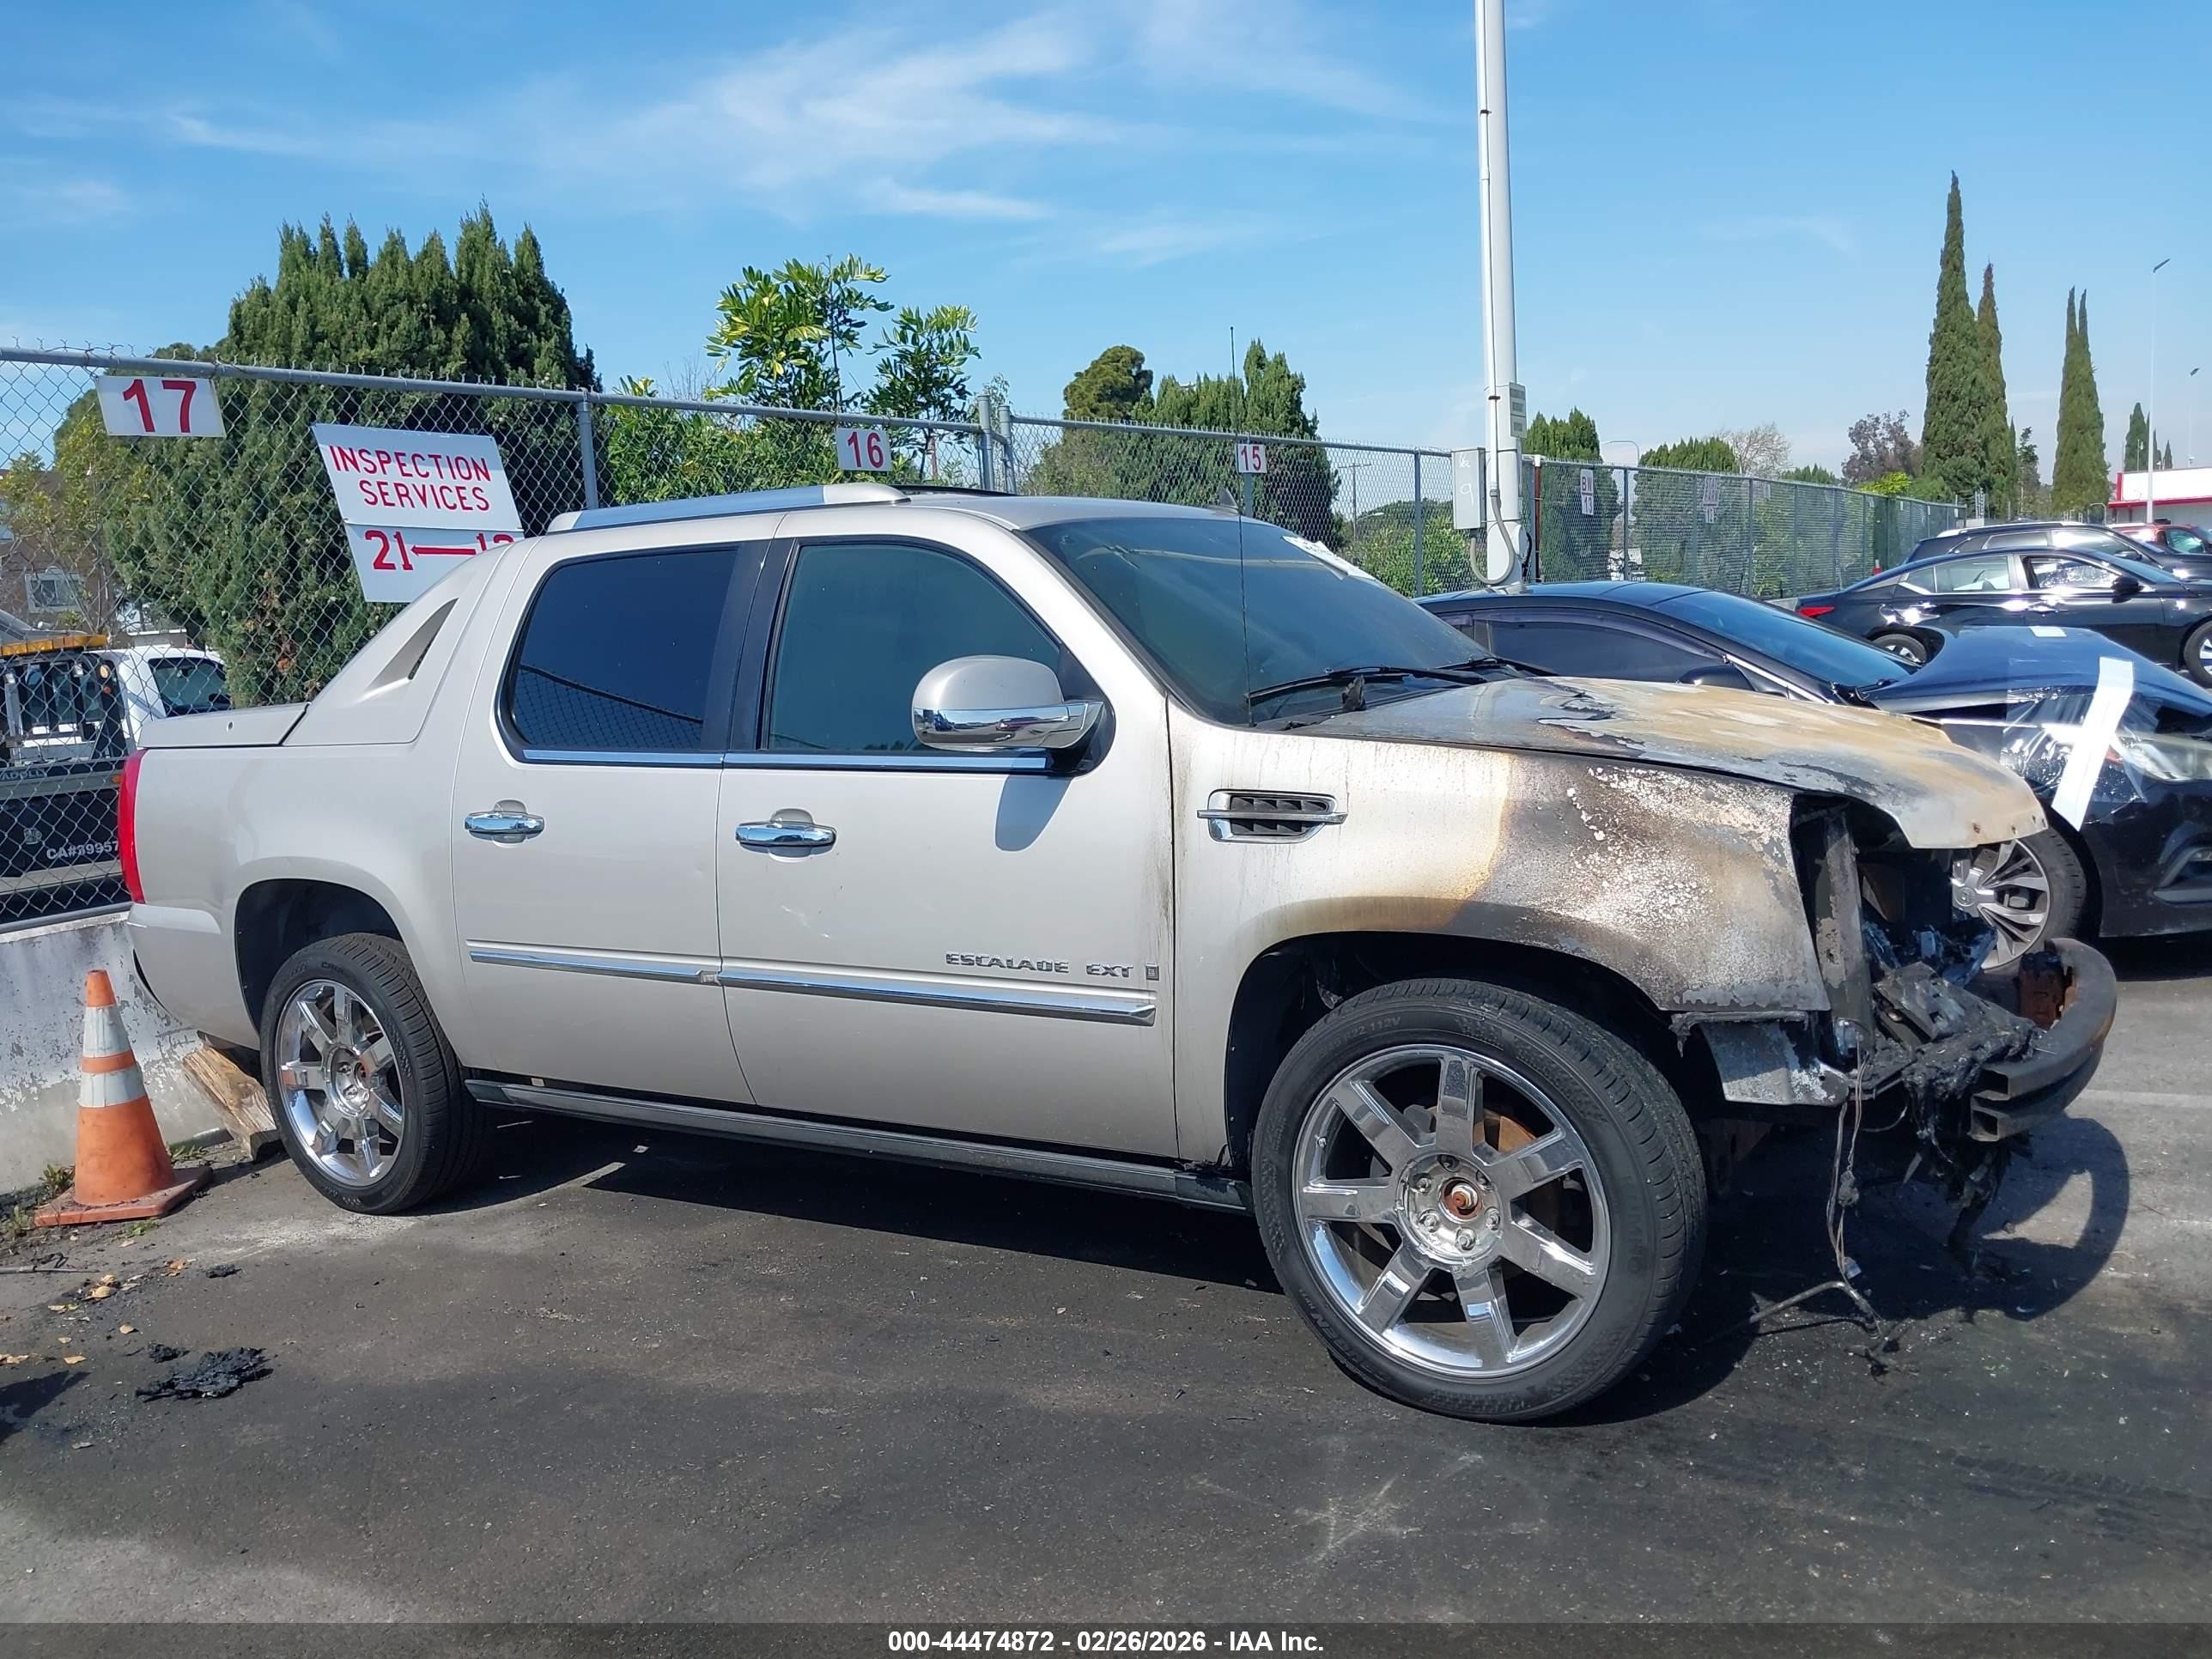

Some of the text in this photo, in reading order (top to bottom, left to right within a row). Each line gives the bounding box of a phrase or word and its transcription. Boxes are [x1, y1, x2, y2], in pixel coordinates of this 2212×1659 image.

[123, 379, 197, 433] 17
[329, 445, 491, 482] INSPECTION
[848, 431, 884, 468] 16
[1241, 446, 1261, 471] 15
[358, 479, 490, 511] SERVICES
[364, 530, 414, 571] 21
[945, 952, 1134, 978] ESCALADE EXT
